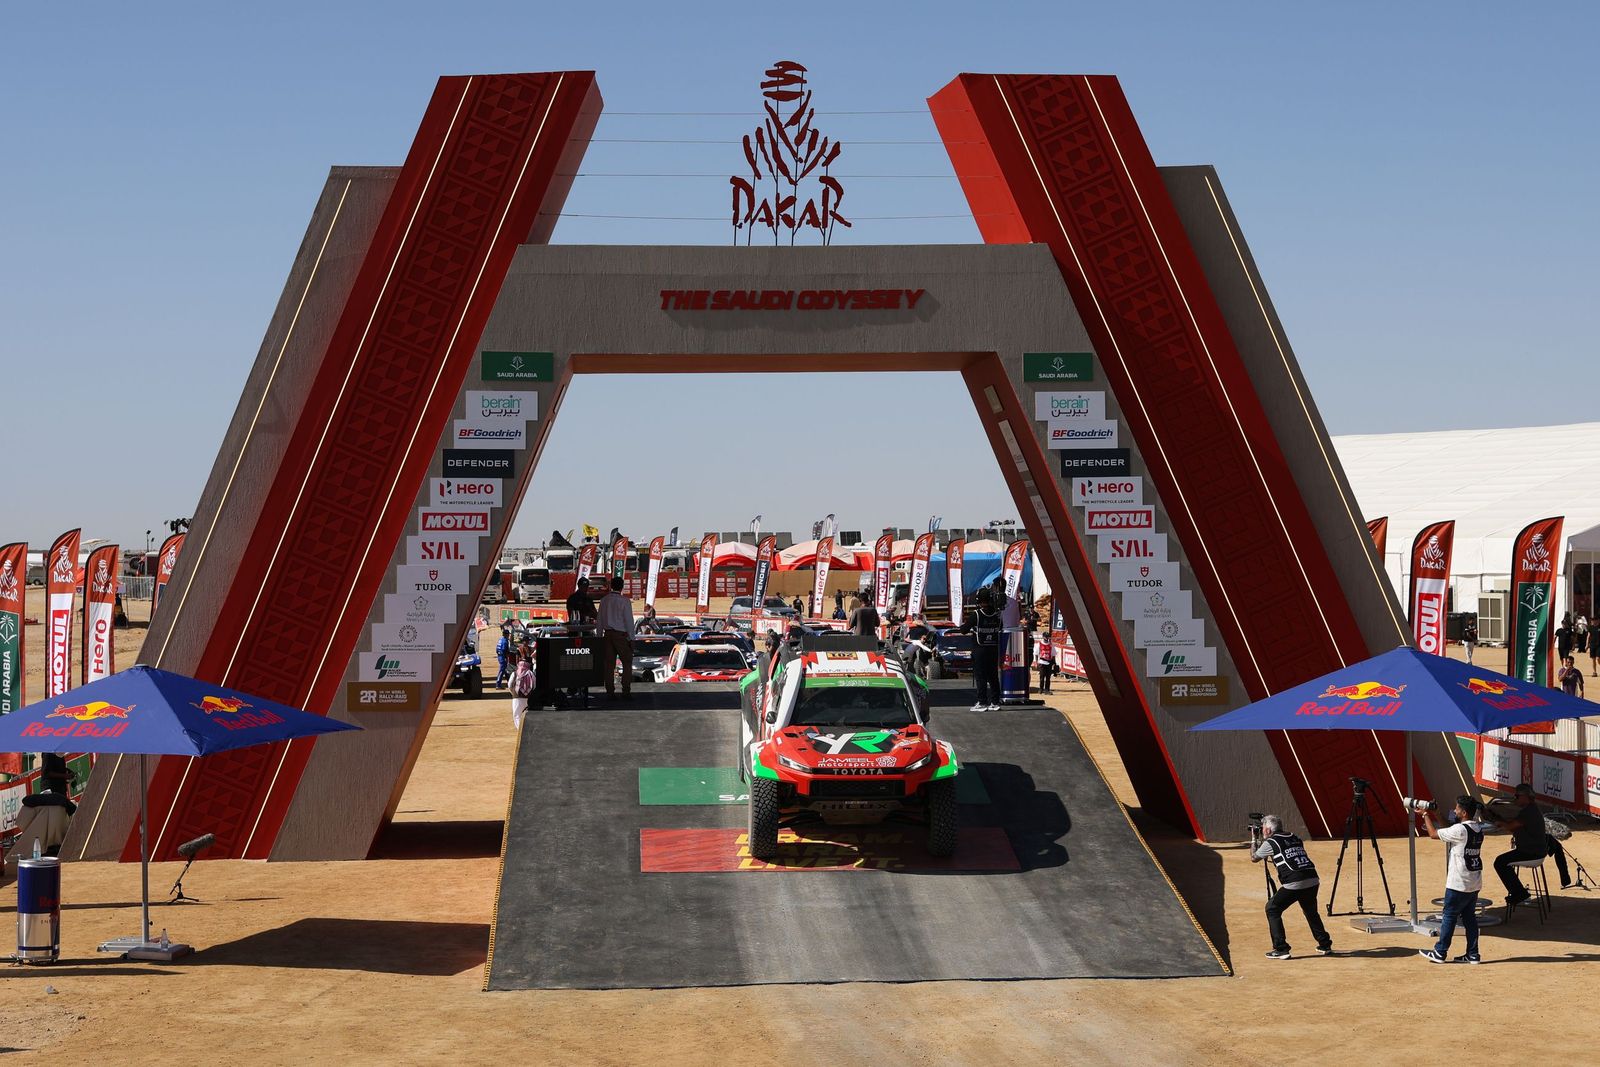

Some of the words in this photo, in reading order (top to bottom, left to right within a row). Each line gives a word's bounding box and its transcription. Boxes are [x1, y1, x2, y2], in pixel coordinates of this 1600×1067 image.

[730, 175, 852, 229] DAKAR
[660, 289, 710, 311] THE
[710, 289, 795, 311] SAUDI
[796, 289, 926, 310] ODYSSEY
[481, 394, 521, 408] berain
[1051, 394, 1089, 408] berain
[481, 408, 520, 418] بيرين
[1051, 408, 1089, 418] بيرين
[458, 429, 522, 438] BFGoodrich
[1052, 429, 1114, 438] BFGoodrich
[447, 459, 509, 468] DEFENDER
[1065, 458, 1125, 467] DEFENDER
[456, 483, 494, 495] Hero
[1097, 483, 1134, 493] Hero
[425, 514, 485, 529] MOTUL
[1091, 512, 1150, 527] MOTUL
[1420, 557, 1445, 570] DAKAR
[1522, 558, 1551, 572] DAKAR
[54, 571, 74, 583] DAKAR
[818, 570, 826, 592] Hero
[1127, 579, 1163, 588] TUDOR
[93, 582, 113, 594] DAKAR
[414, 583, 452, 591] TUDOR
[755, 562, 767, 607] DEFENDER
[879, 569, 888, 606] MOTUL
[913, 572, 923, 605] TUDOR
[1420, 597, 1438, 656] OTUL
[94, 618, 106, 674] Hero
[1526, 618, 1537, 662] ARABIA
[3, 650, 11, 696] ARABIA
[1526, 662, 1535, 684] UDI
[1296, 702, 1347, 716] Red
[1347, 702, 1403, 716] Bull
[213, 714, 252, 731] Red
[249, 709, 286, 727] Bull
[20, 722, 73, 738] Red
[72, 722, 129, 738] Bull
[832, 768, 884, 776] TOYOTA
[1543, 760, 1564, 781] berain
